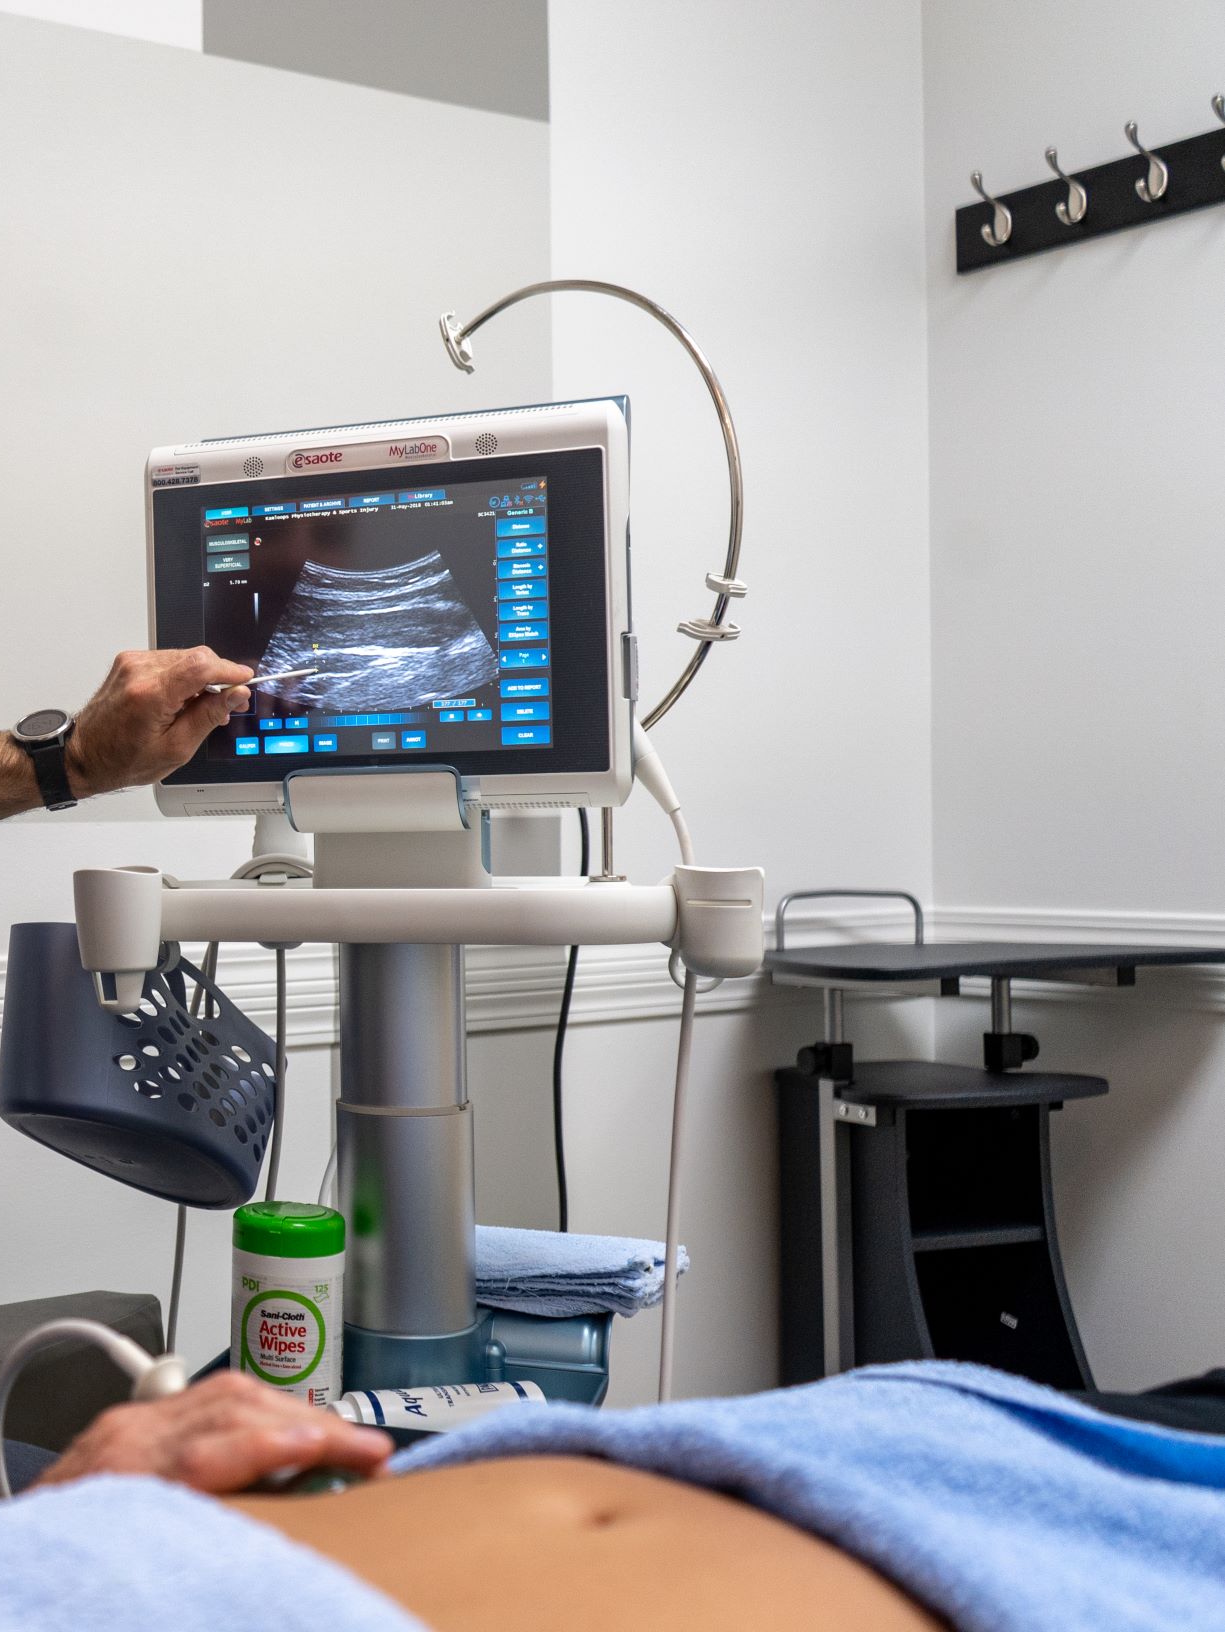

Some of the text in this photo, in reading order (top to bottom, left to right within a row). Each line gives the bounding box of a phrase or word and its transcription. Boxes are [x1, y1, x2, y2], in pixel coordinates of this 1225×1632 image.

[389, 443, 437, 458] MyLabOne
[292, 451, 342, 468] esaote
[242, 1276, 260, 1292] PDI
[314, 1284, 329, 1293] 125
[260, 1310, 305, 1321] Sani-Cloth
[259, 1320, 307, 1337] Active
[259, 1335, 306, 1355] Wipes
[275, 1355, 296, 1363] Surface
